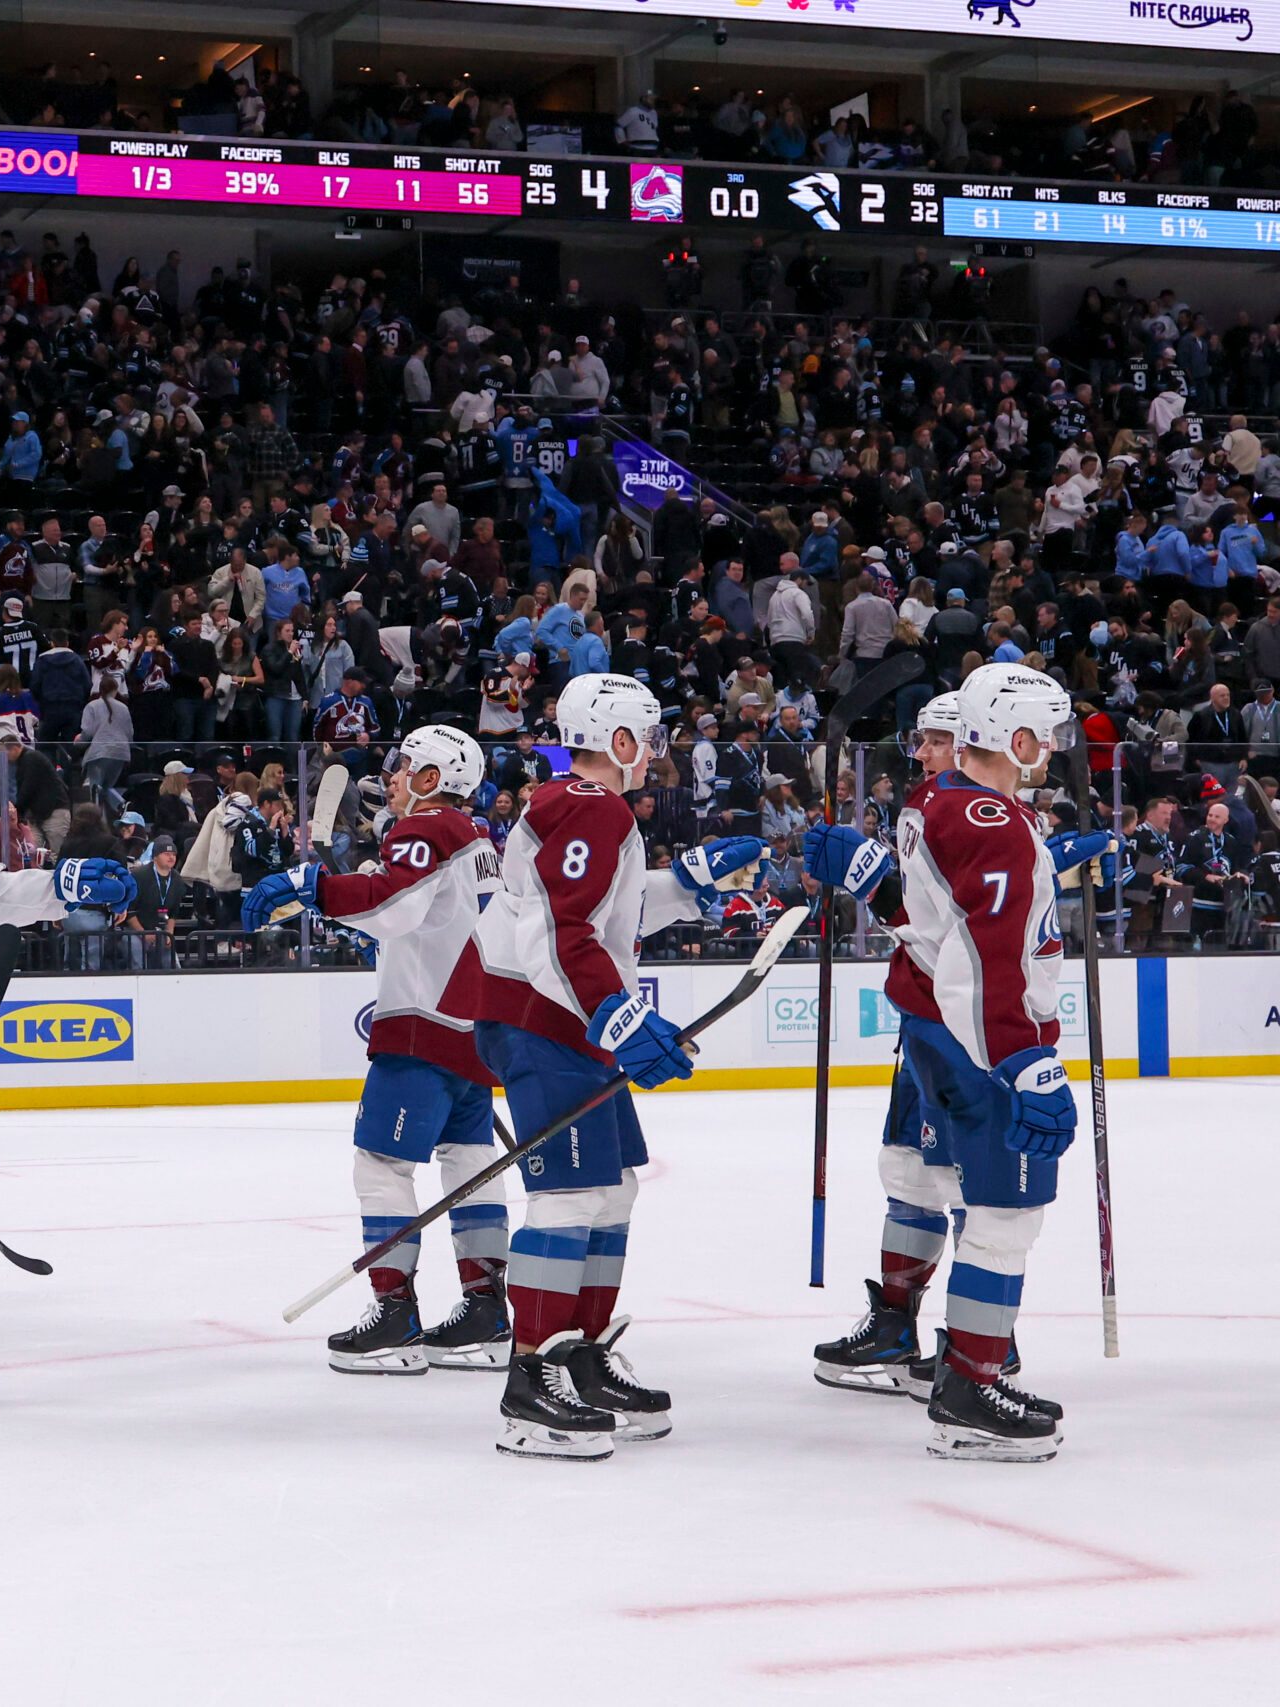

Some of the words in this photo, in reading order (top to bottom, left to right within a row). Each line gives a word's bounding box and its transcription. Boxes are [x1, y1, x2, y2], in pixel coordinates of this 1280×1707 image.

[221, 146, 282, 162] FACEOFFS
[318, 151, 350, 166] BLKS
[393, 155, 420, 169] HITS
[445, 158, 475, 172] SHOT
[476, 160, 501, 174] ATT
[529, 164, 553, 177] SOG
[131, 166, 172, 191] 1/3
[225, 171, 280, 195] 39%
[322, 176, 351, 198] 17
[727, 174, 745, 183] 3RD
[395, 179, 420, 202] 11
[458, 183, 489, 205] 56
[526, 182, 556, 205] 25
[581, 170, 610, 209] 4
[913, 183, 935, 197] SOG
[962, 184, 991, 198] SHOT
[992, 186, 1013, 199] ATT
[1035, 188, 1059, 200] HITS
[1098, 191, 1126, 204] BLKS
[710, 187, 760, 218] 0.0
[861, 183, 886, 223] 2
[1157, 194, 1209, 208] FACEOFFS
[345, 216, 356, 227] 17
[376, 217, 382, 228] U
[910, 201, 938, 223] 32
[973, 208, 1000, 229] 61
[1034, 211, 1060, 232] 21
[1102, 214, 1127, 235] 14
[1160, 217, 1208, 239] 61%
[1023, 246, 1034, 257] 19
[1134, 371, 1147, 391] 9
[1188, 424, 1204, 443] 9
[538, 449, 565, 475] 98
[961, 503, 988, 532] UTAH
[3, 630, 33, 644] PETERKA
[3, 640, 37, 672] 77
[487, 678, 495, 691] 8
[433, 727, 466, 747] Kiewit
[705, 759, 714, 771] 9
[241, 826, 253, 842] 9
[391, 841, 431, 869] 70
[561, 839, 591, 880] 8
[982, 872, 1007, 915] 7
[3, 1018, 122, 1044] IKEA
[776, 1023, 810, 1032] PROTEIN
[1061, 1017, 1077, 1025] BAR
[1092, 1064, 1106, 1127] BAUER
[393, 1107, 407, 1142] CCM
[570, 1126, 581, 1169] BAUER
